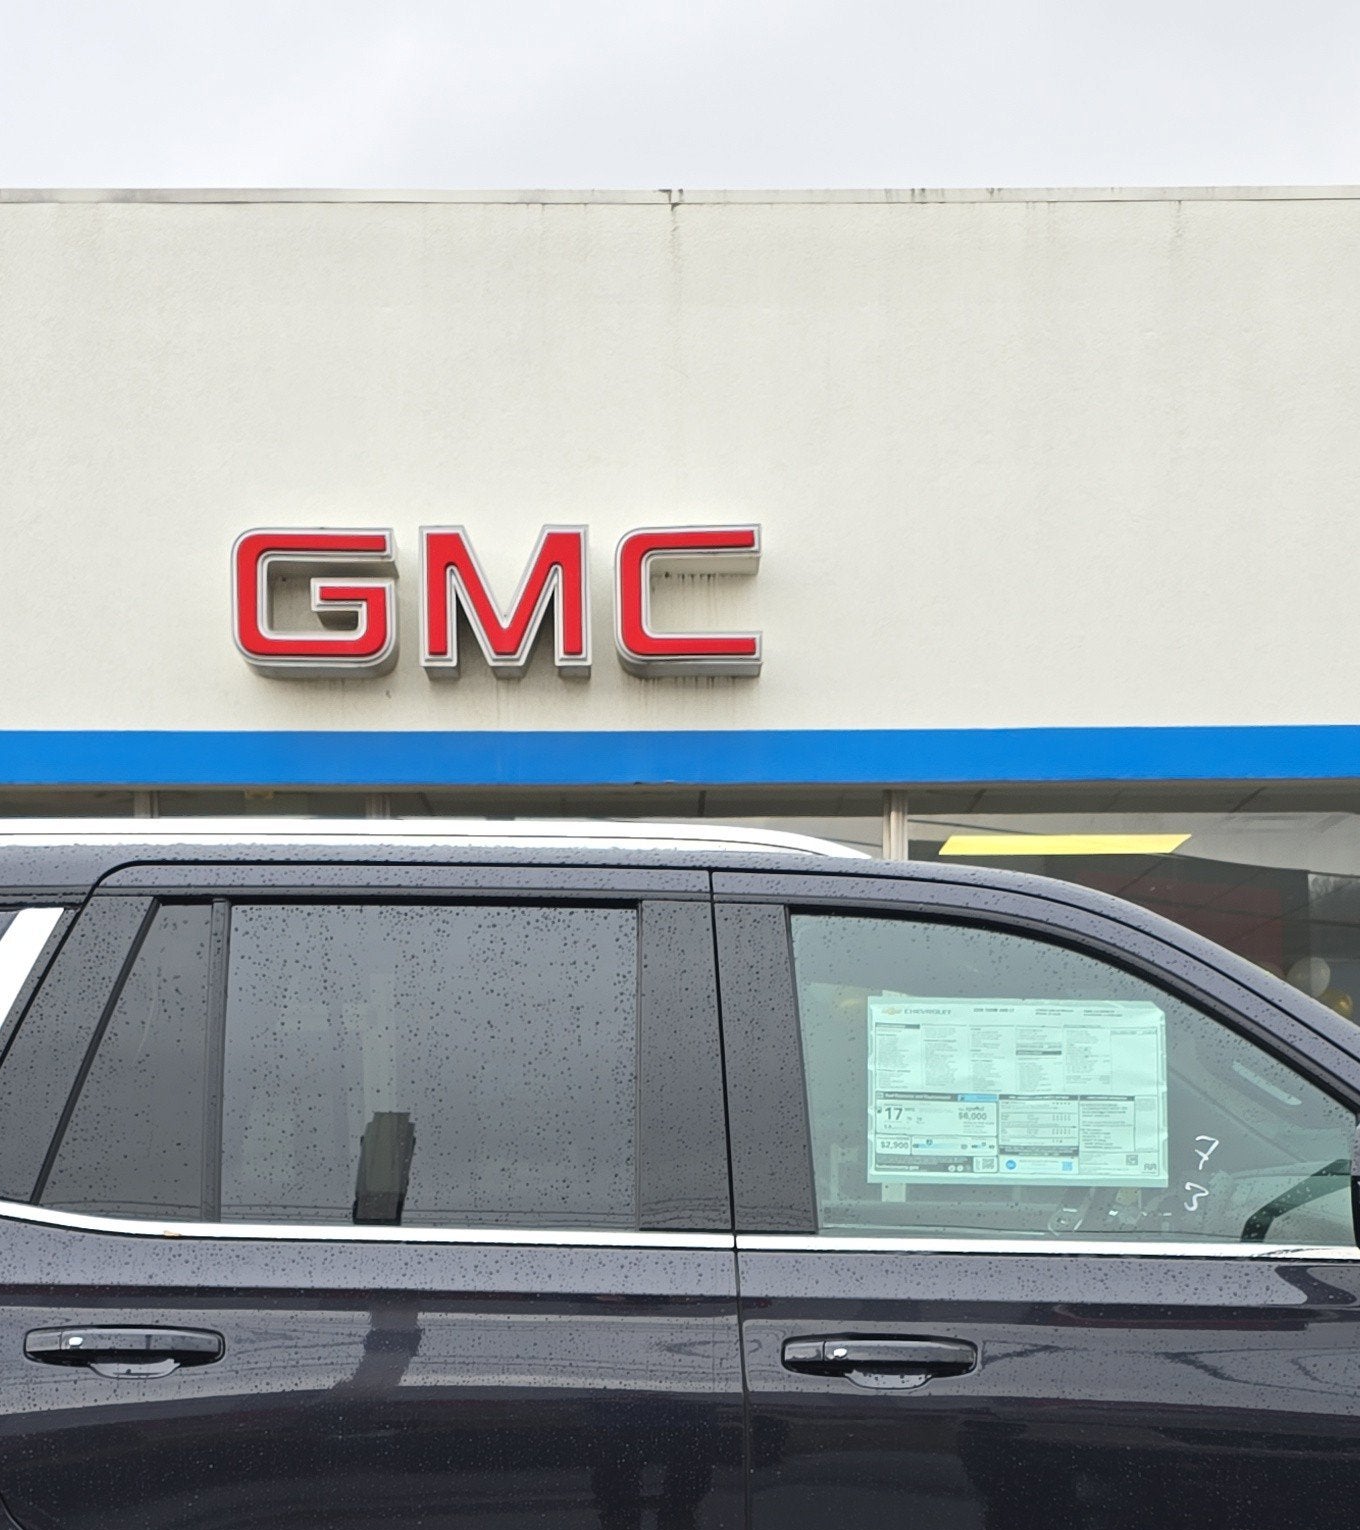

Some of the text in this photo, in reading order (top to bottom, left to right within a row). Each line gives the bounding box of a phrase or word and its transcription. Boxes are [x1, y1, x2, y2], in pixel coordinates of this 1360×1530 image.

[231, 523, 762, 675] GMC
[884, 1107, 903, 1120] 17
[1194, 1135, 1220, 1171] 7
